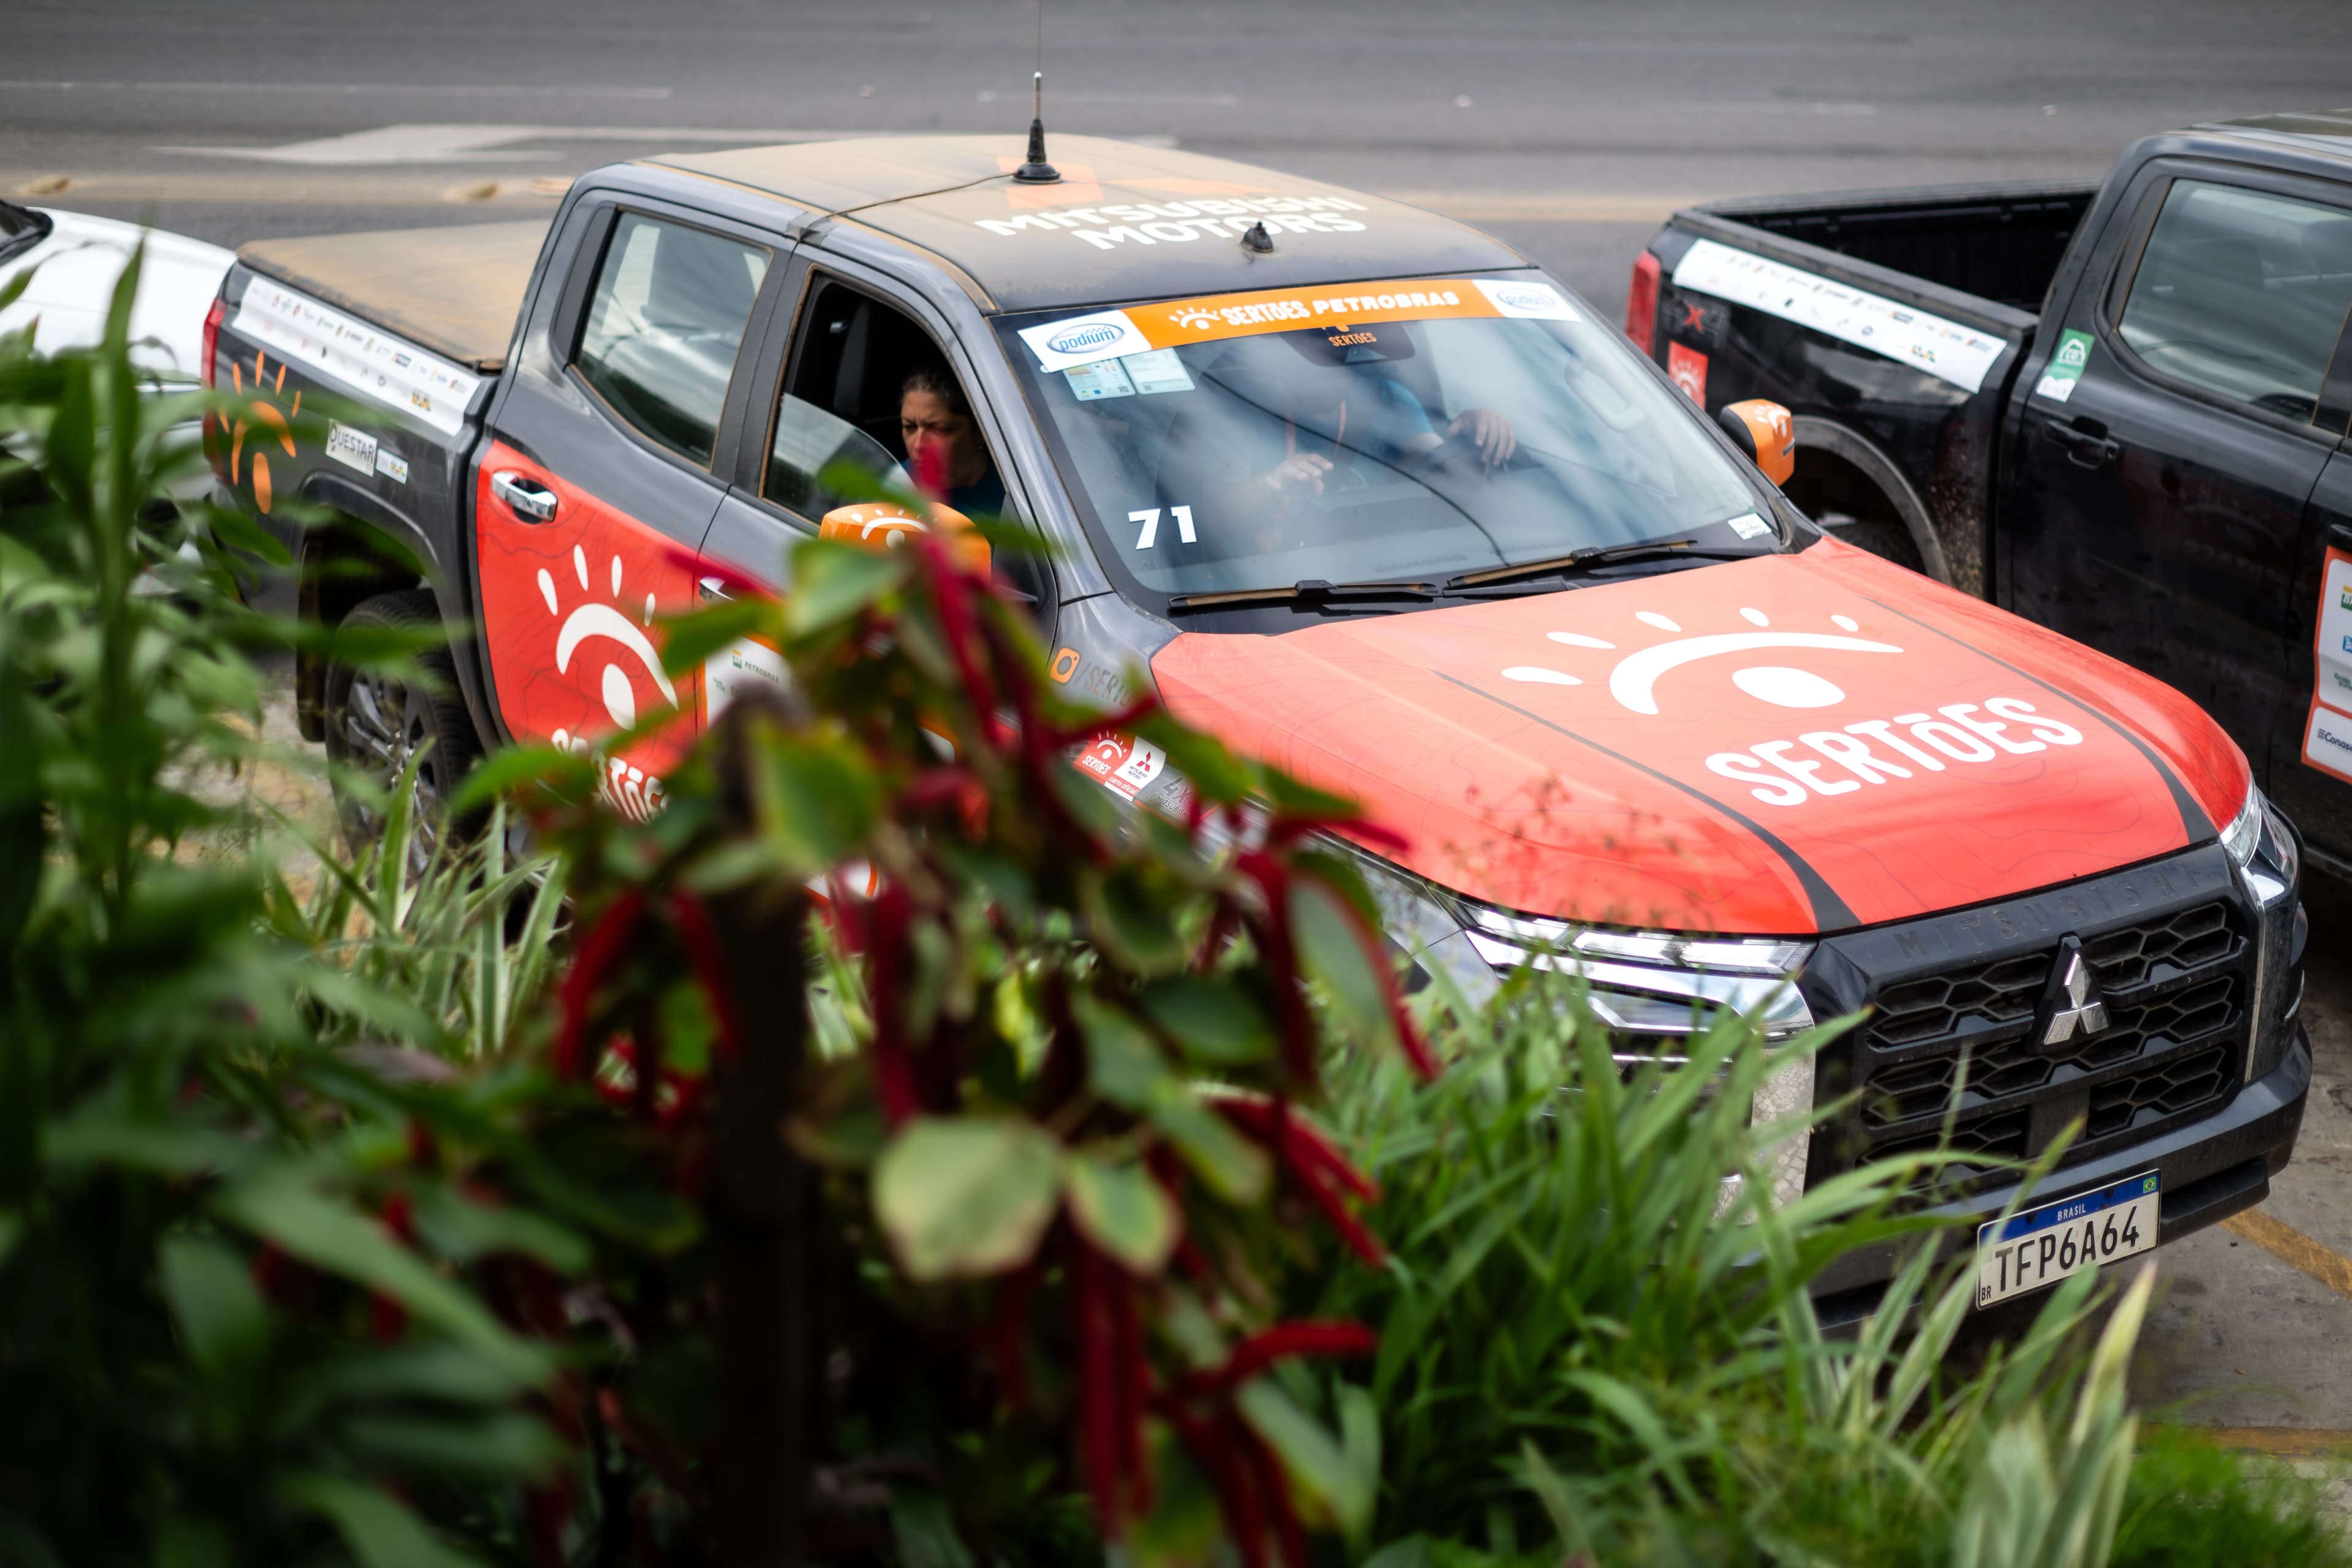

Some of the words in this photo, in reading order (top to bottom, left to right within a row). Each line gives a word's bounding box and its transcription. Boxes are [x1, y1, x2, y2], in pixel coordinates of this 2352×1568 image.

[974, 196, 1370, 236] MITSUBISHI
[1072, 213, 1366, 250] MOTORS
[1313, 291, 1460, 314] PETROBRAS
[1058, 330, 1115, 352] podium
[330, 424, 374, 464] QUESTAR
[1128, 505, 1197, 550] 71
[744, 662, 779, 684] PETROBRAS
[1156, 794, 1189, 818] MITSUBISH
[1892, 861, 2199, 961] MITSUBISHI
[2057, 1203, 2087, 1221] BRASIL
[1995, 1205, 2139, 1292] TFP6A64
[1981, 1285, 1991, 1302] BR
